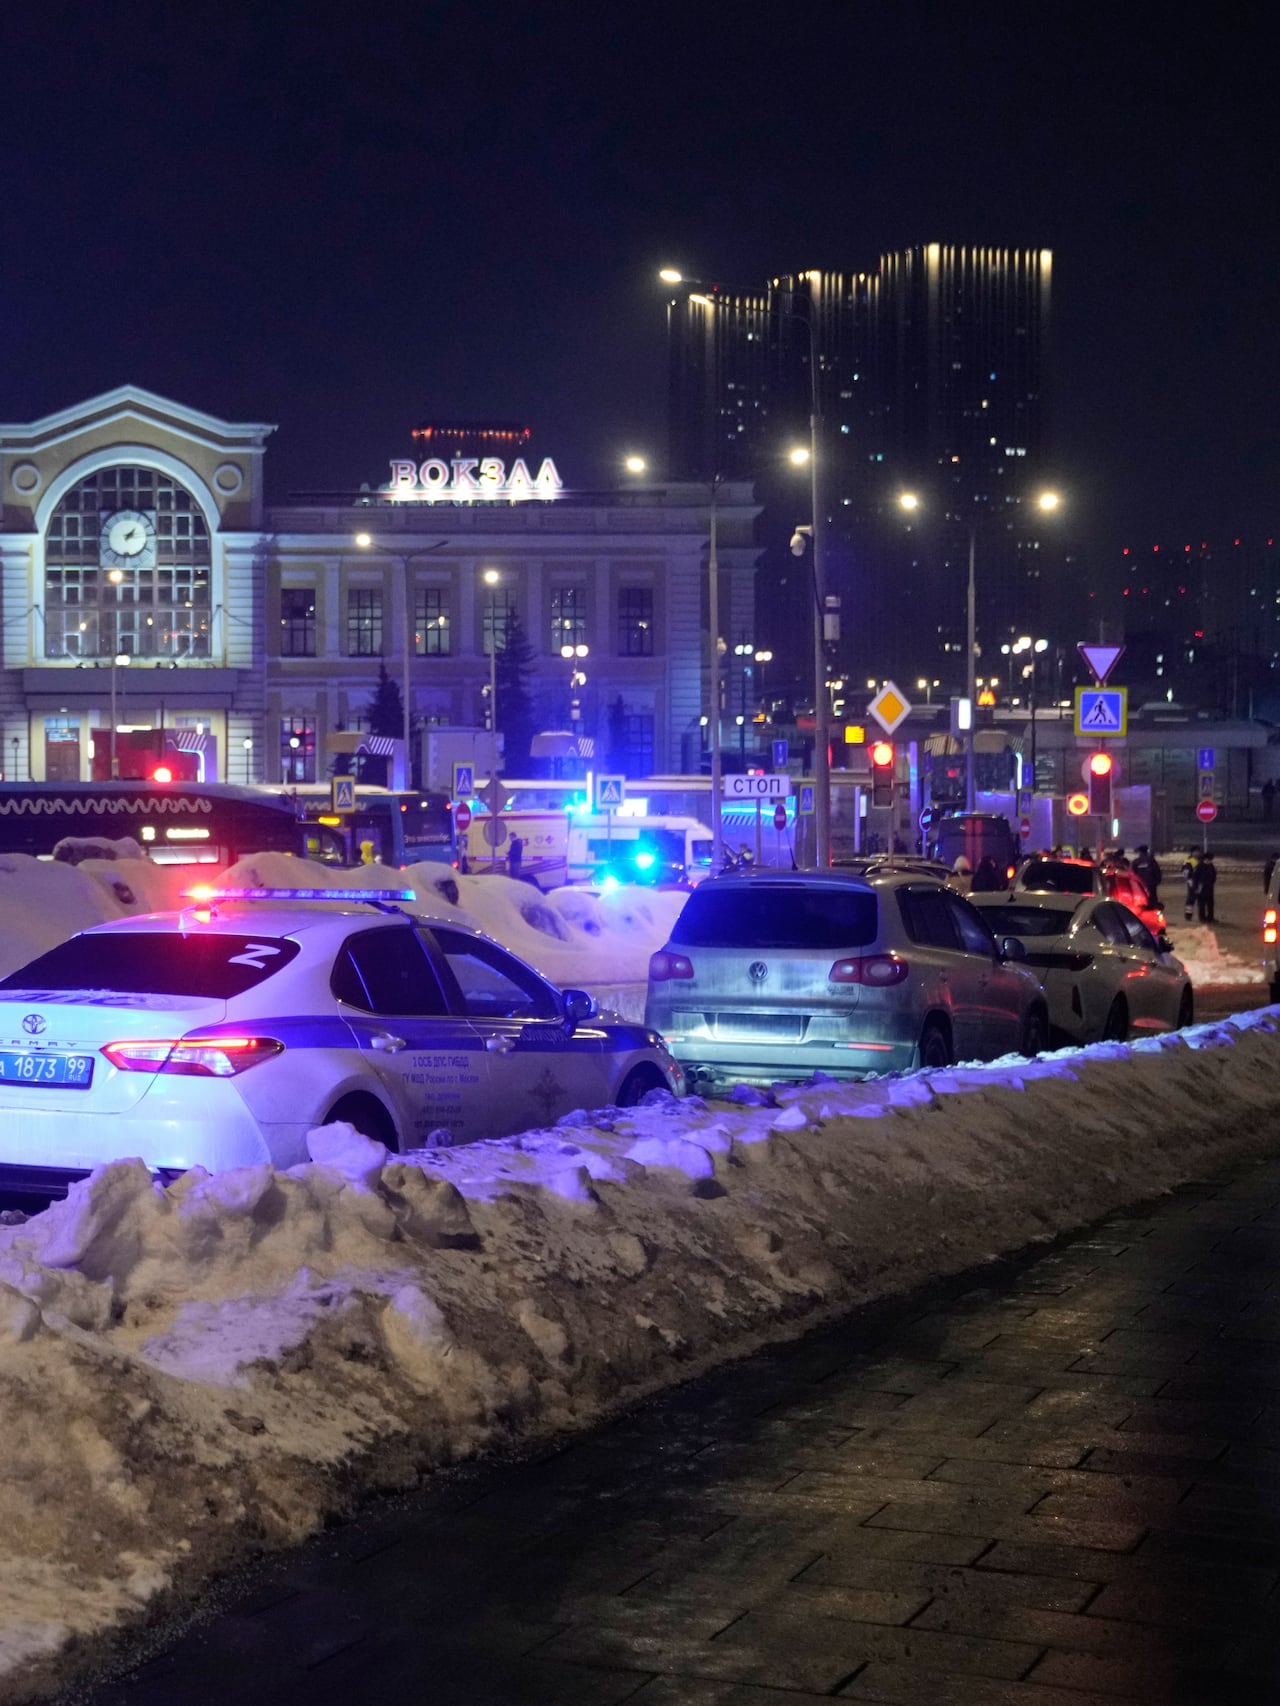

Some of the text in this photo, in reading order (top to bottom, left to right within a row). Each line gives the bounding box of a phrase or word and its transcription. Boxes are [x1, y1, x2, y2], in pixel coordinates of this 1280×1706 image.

[389, 457, 562, 490] ВОКЗАЛ
[733, 778, 781, 793] СТОП
[227, 943, 282, 969] Z
[13, 1056, 58, 1079] 1873
[67, 1057, 86, 1075] 99
[68, 1074, 82, 1082] RUS
